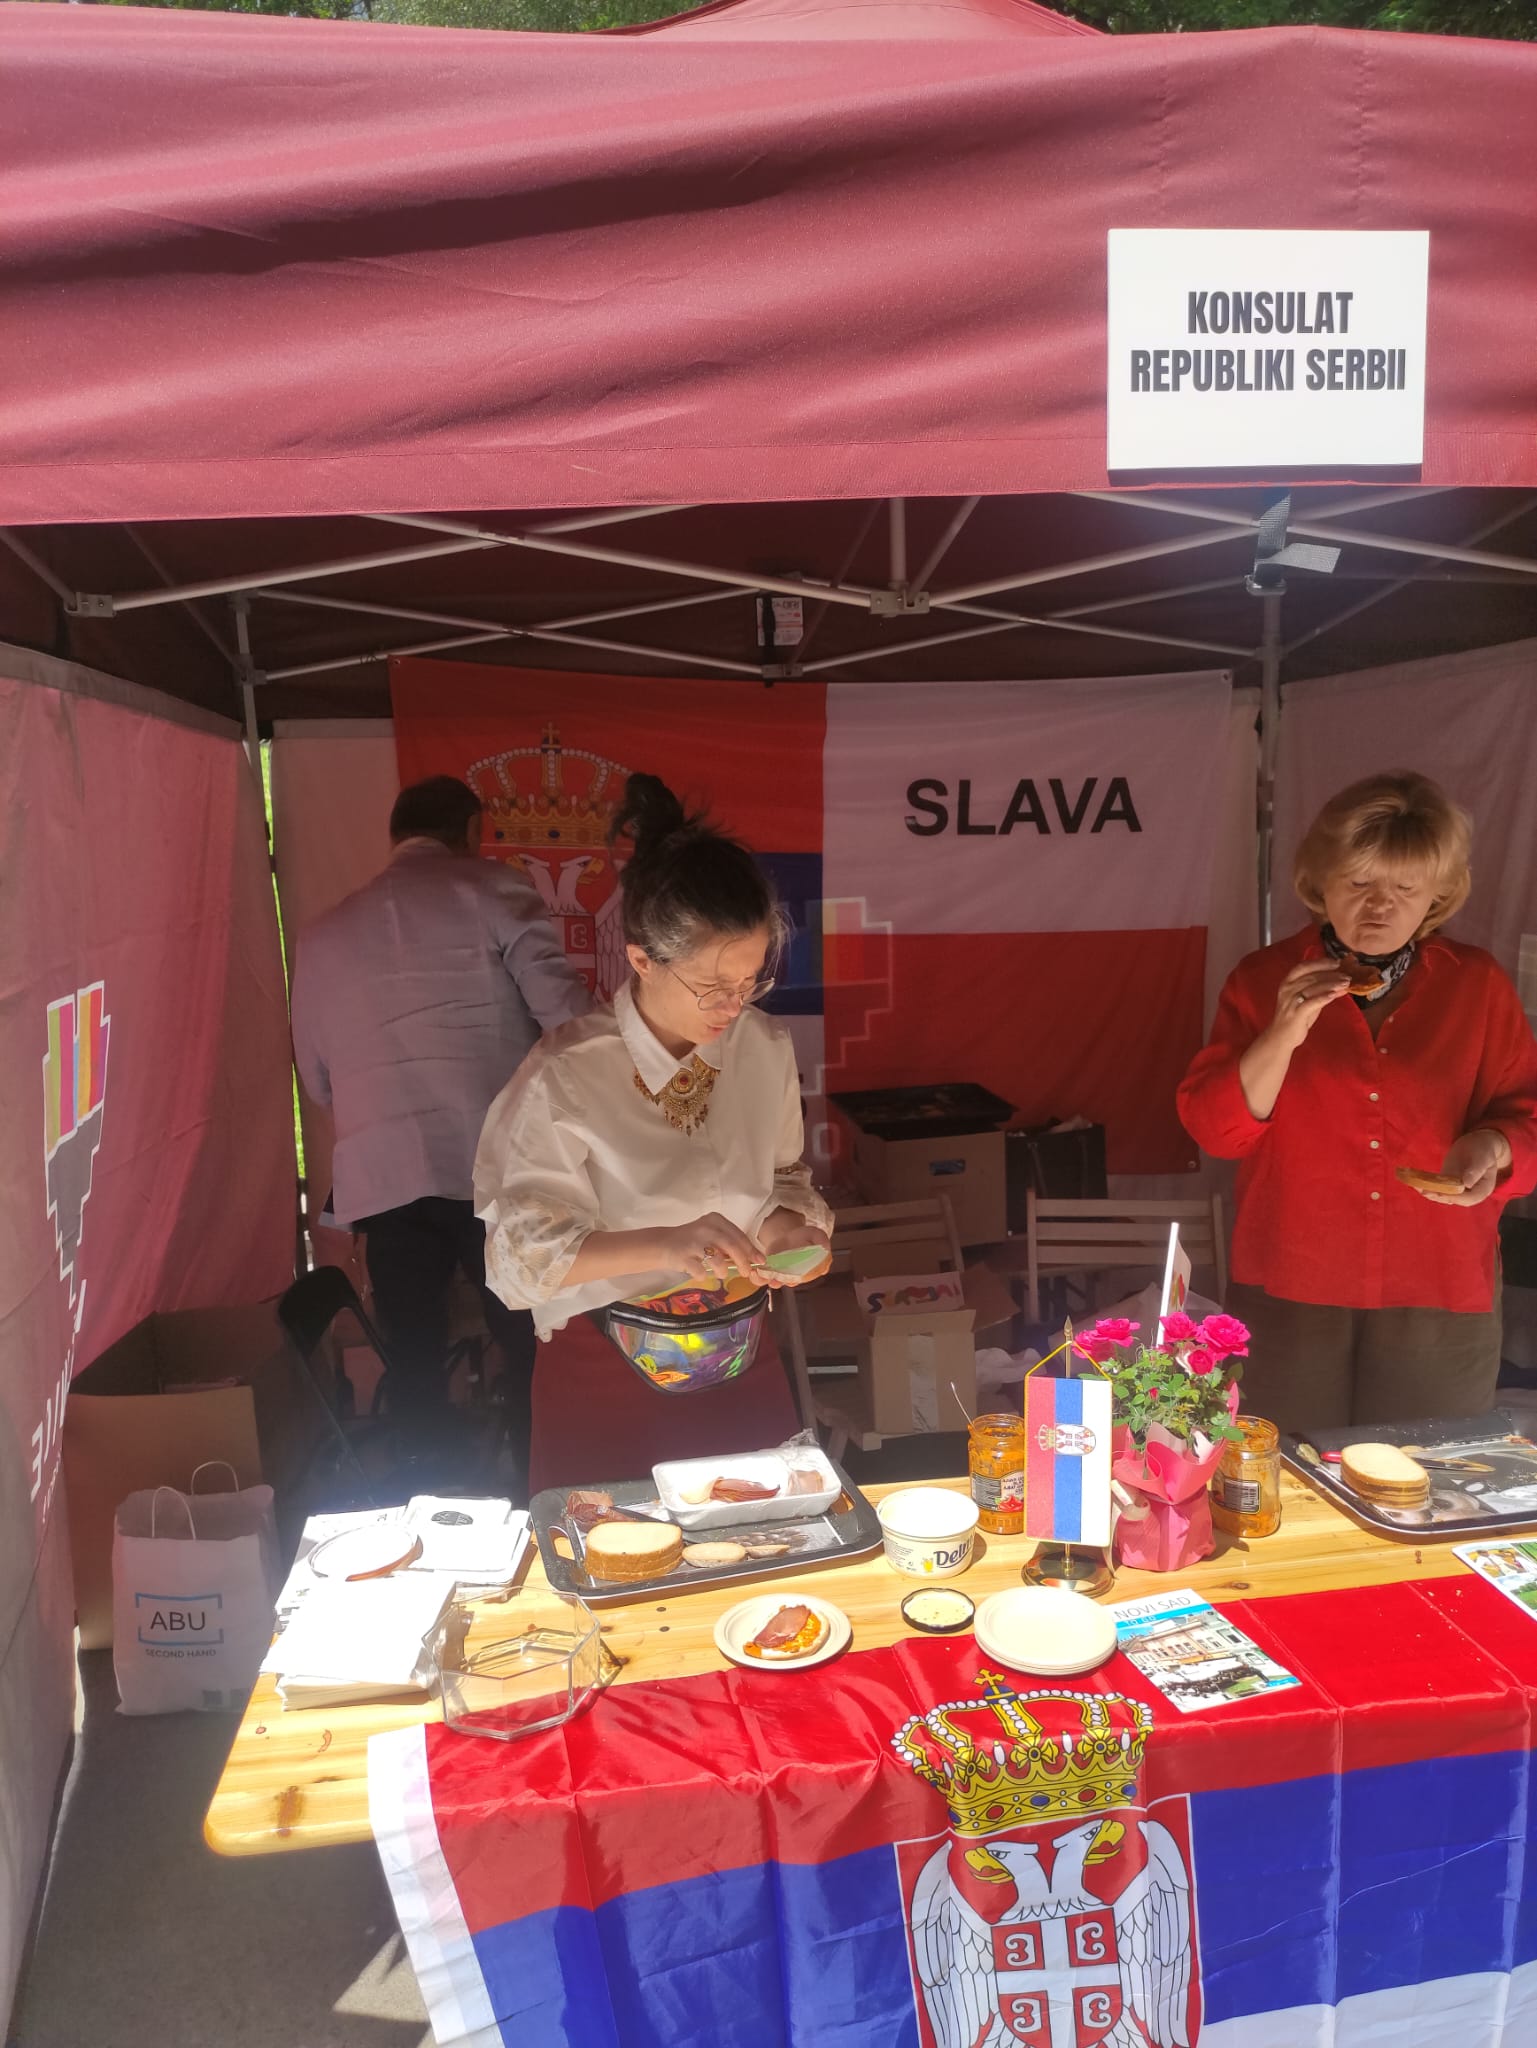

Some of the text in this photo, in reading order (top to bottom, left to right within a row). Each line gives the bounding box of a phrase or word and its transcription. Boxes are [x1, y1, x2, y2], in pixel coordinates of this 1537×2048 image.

[1187, 291, 1354, 334] KONSULAT
[1130, 348, 1407, 392] REPUBLIKI SERBII
[904, 777, 1142, 837] SLAVA
[150, 1611, 206, 1631] ABU
[1114, 1596, 1192, 1620] NOVI SAD
[145, 1648, 217, 1658] SECOND HAND
